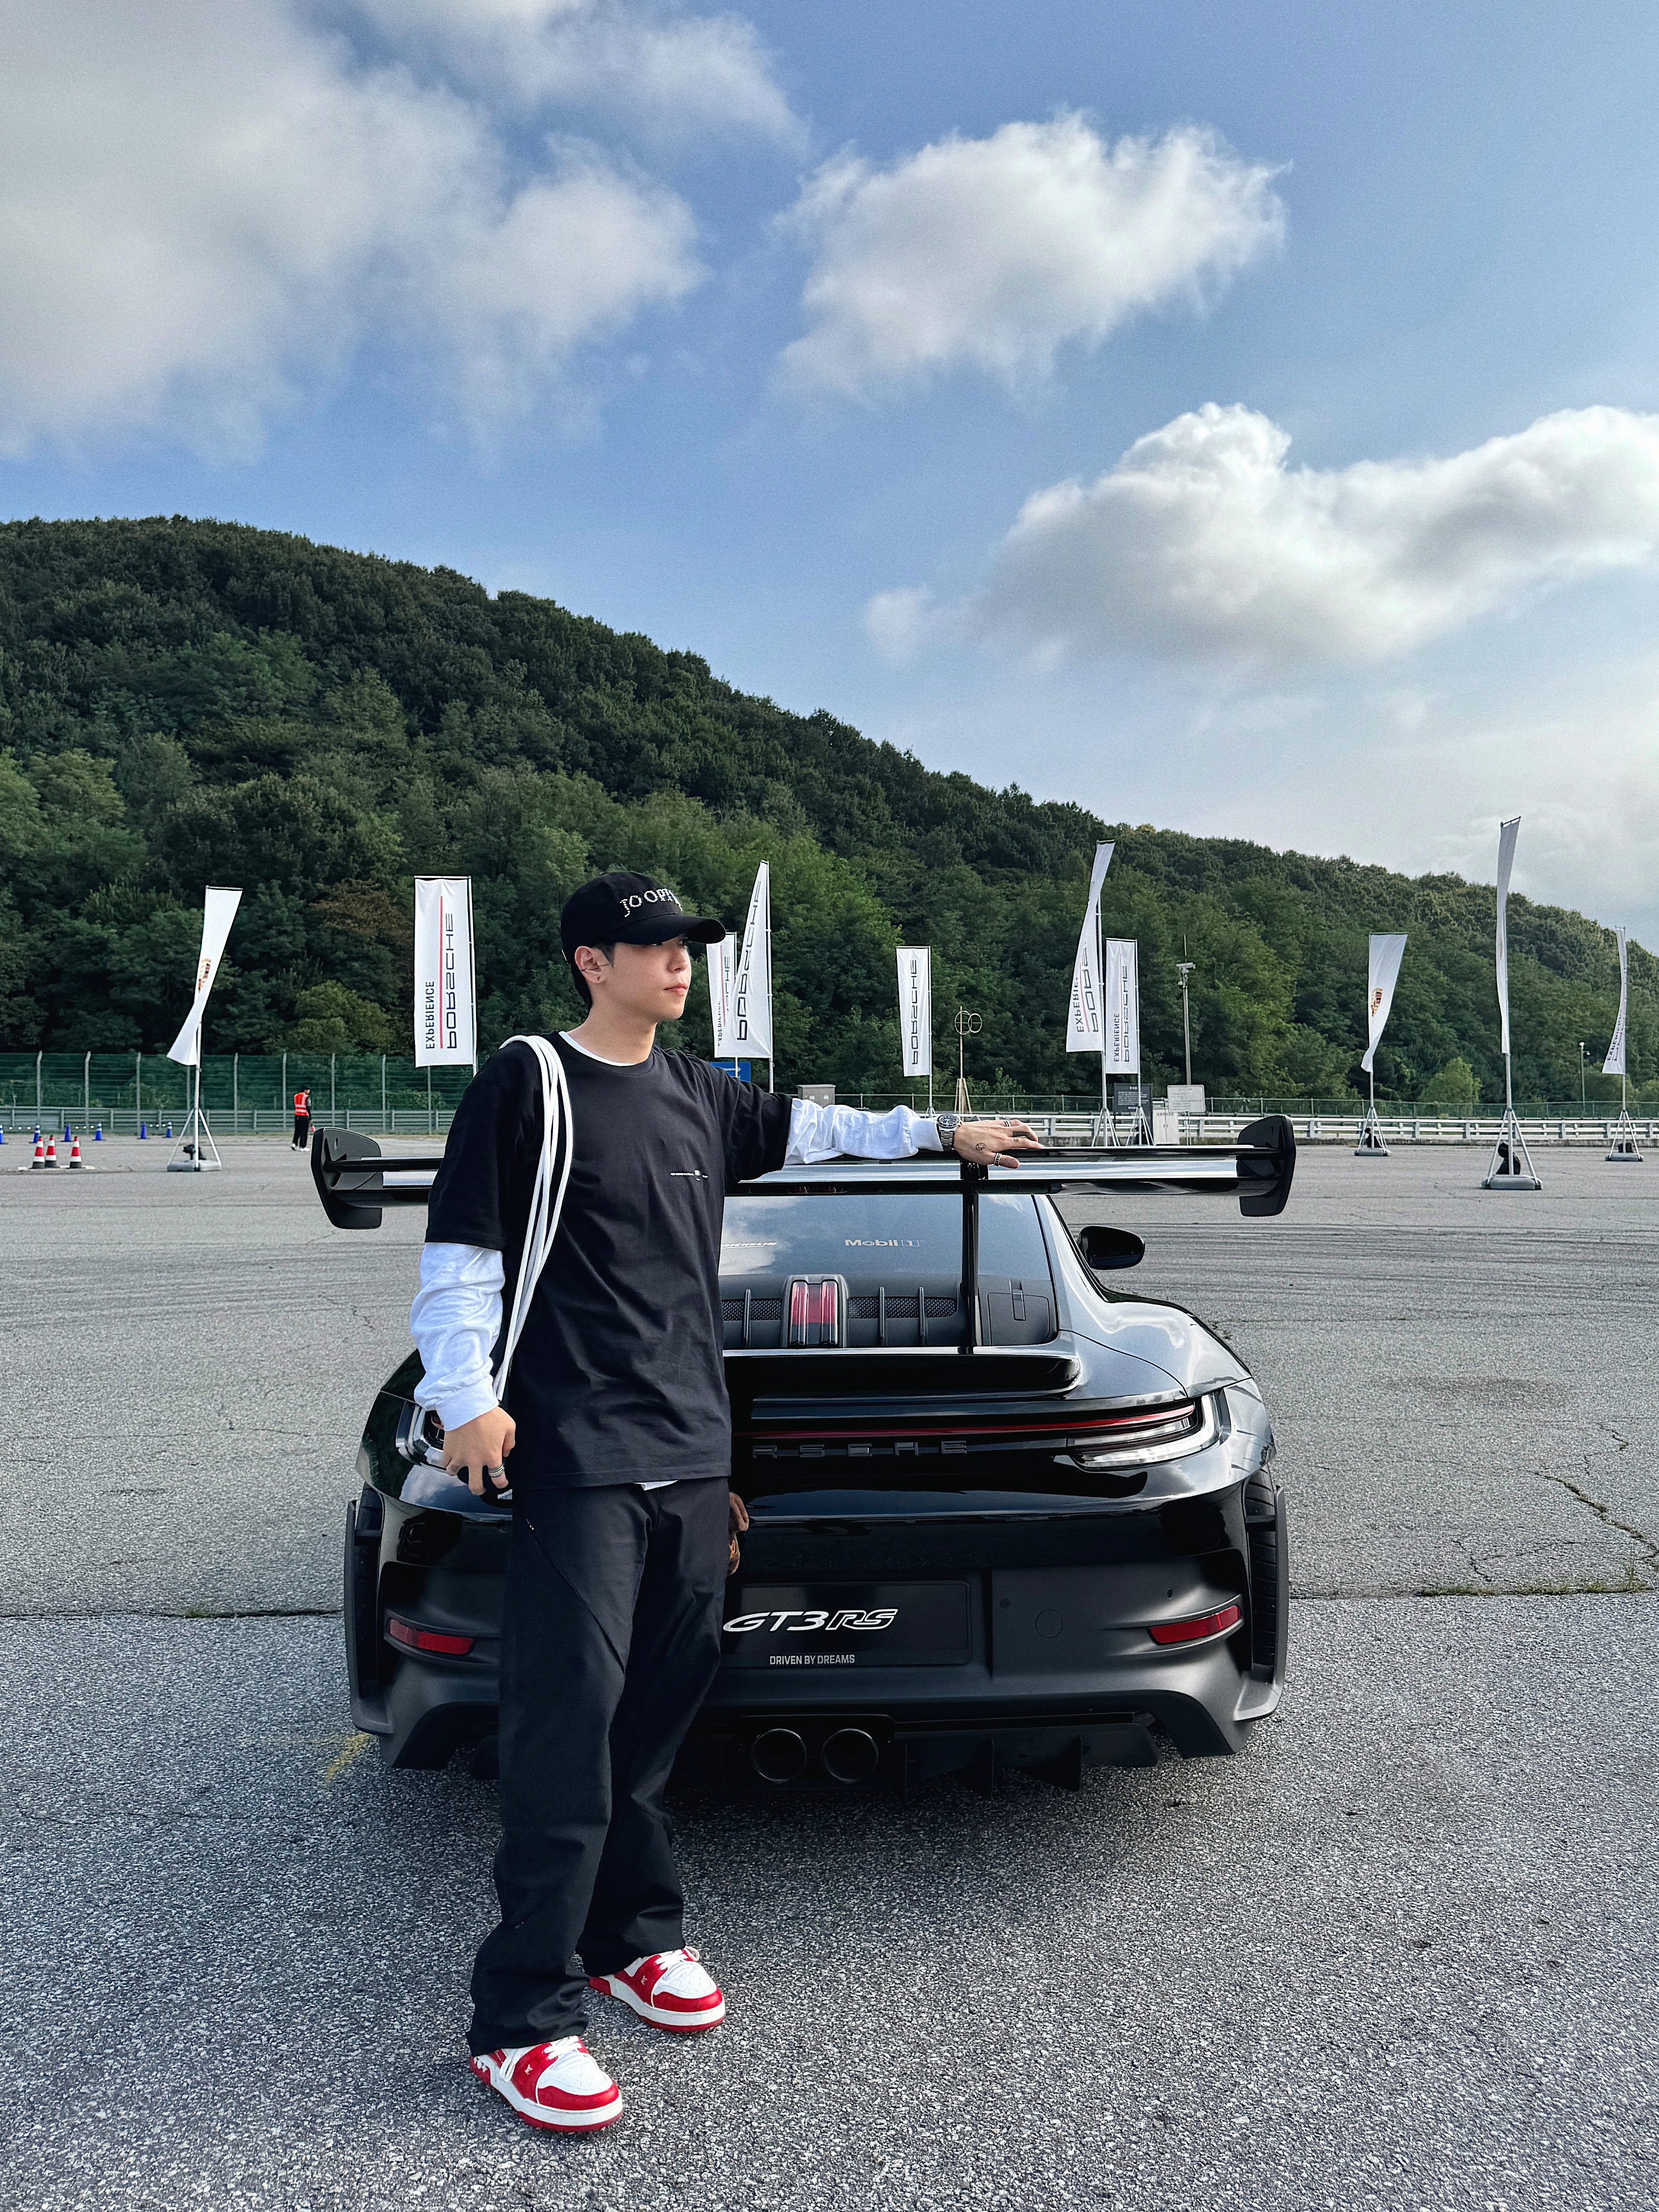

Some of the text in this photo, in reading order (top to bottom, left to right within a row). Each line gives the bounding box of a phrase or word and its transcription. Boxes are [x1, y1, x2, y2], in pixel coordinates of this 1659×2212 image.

[770, 1654, 855, 1665] DRIVEN BY DREAMS
